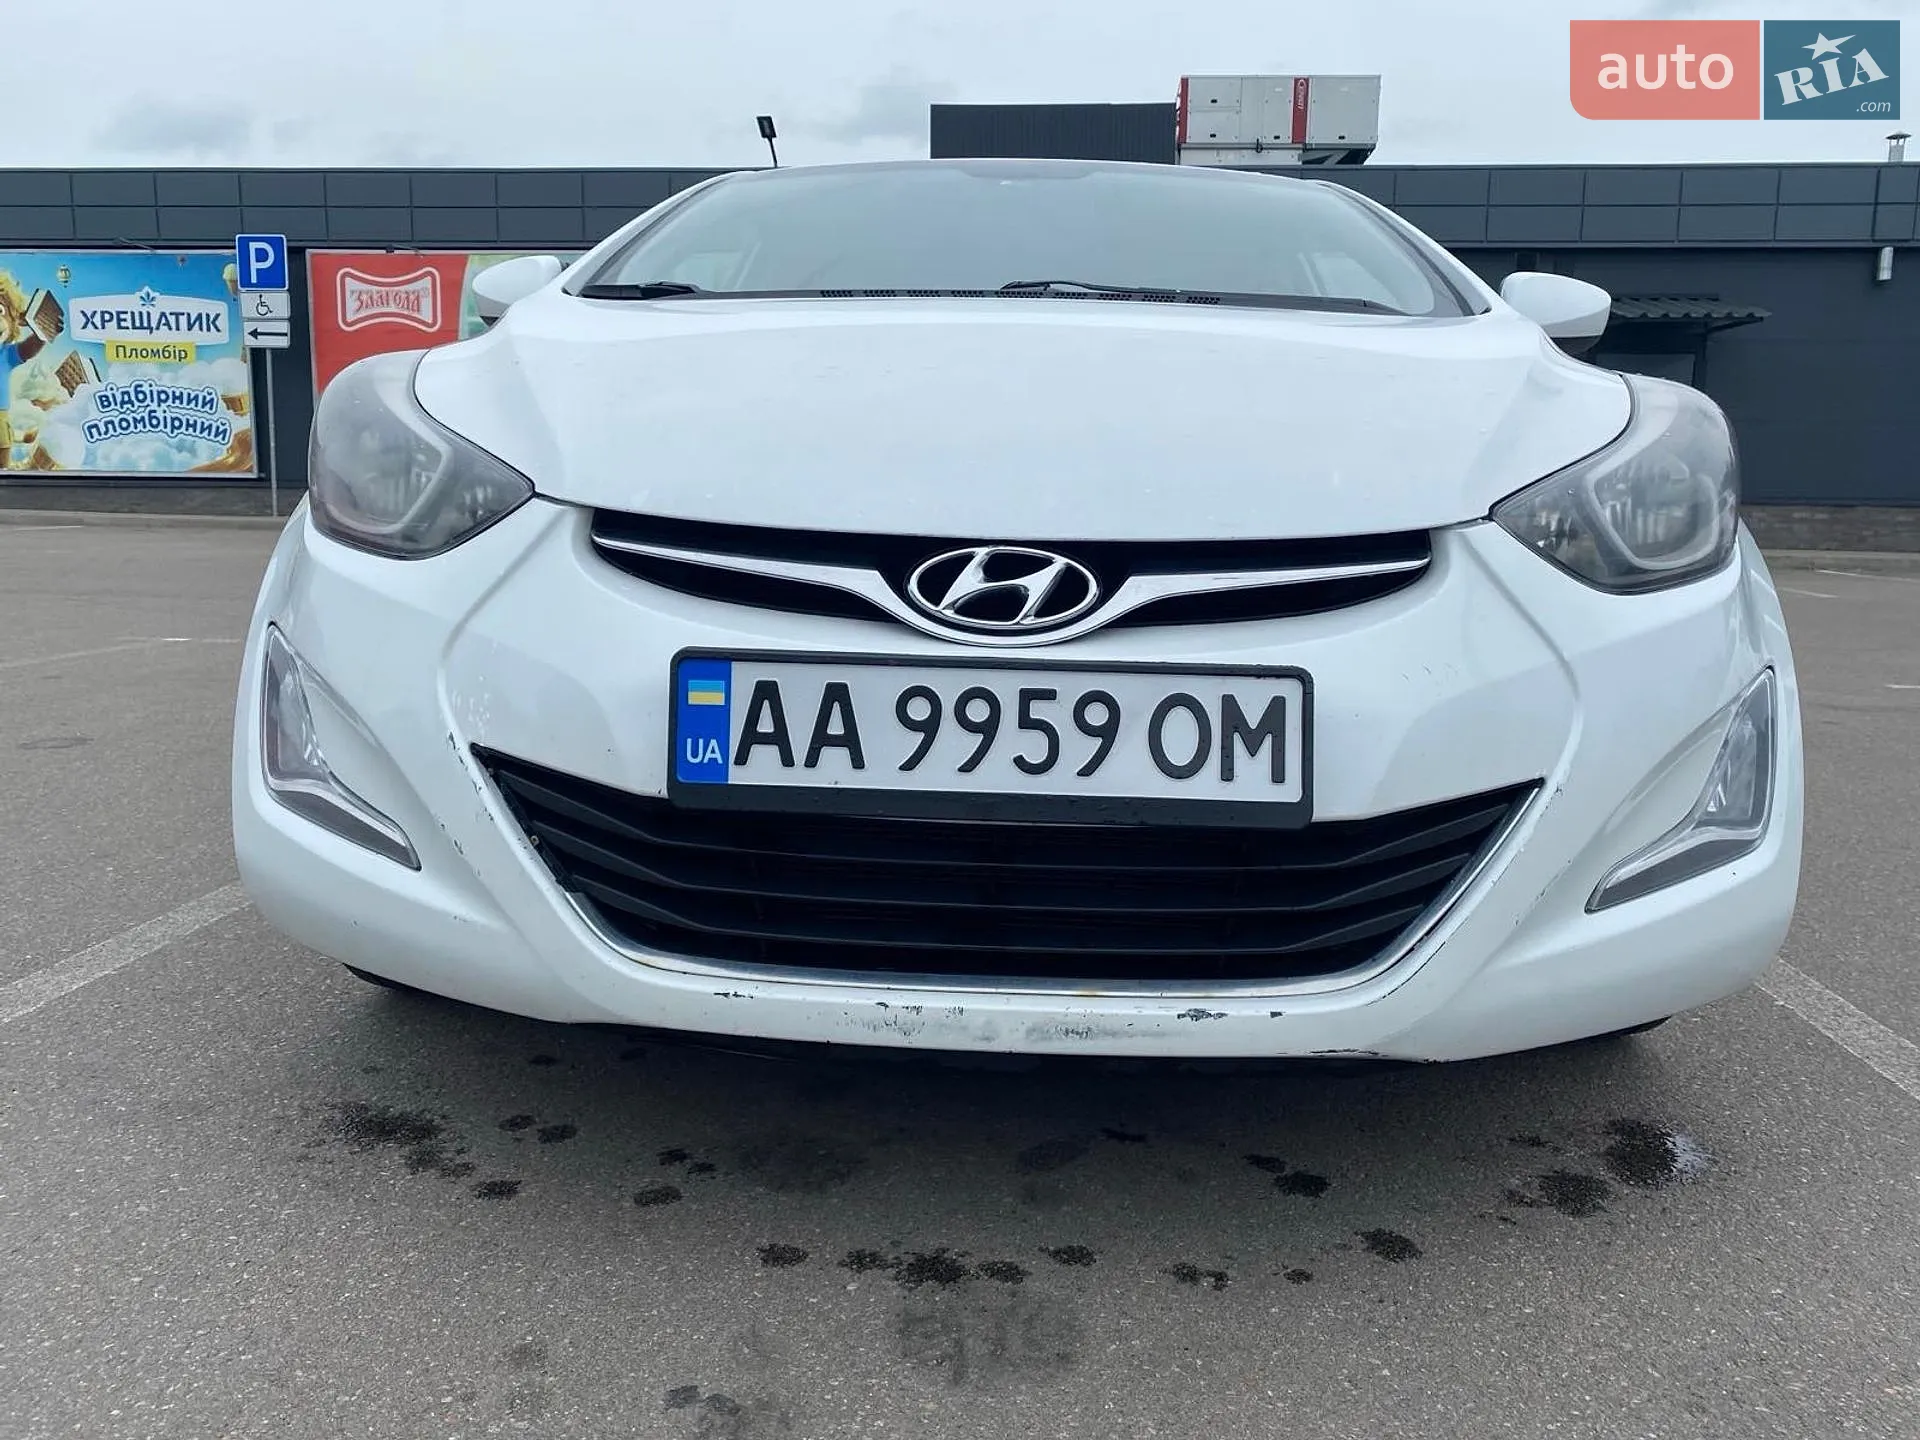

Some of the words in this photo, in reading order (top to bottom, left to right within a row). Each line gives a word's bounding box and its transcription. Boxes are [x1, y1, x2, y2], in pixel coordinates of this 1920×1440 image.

[248, 241, 275, 284] P
[79, 309, 222, 335] ХРЕЩАТИК
[115, 344, 189, 362] Пломбір
[96, 379, 217, 412] відбірний
[86, 407, 230, 442] пломбірний
[734, 679, 866, 770] AA
[895, 684, 1122, 777] 9959
[1148, 692, 1286, 785] OM
[686, 737, 723, 765] UA
